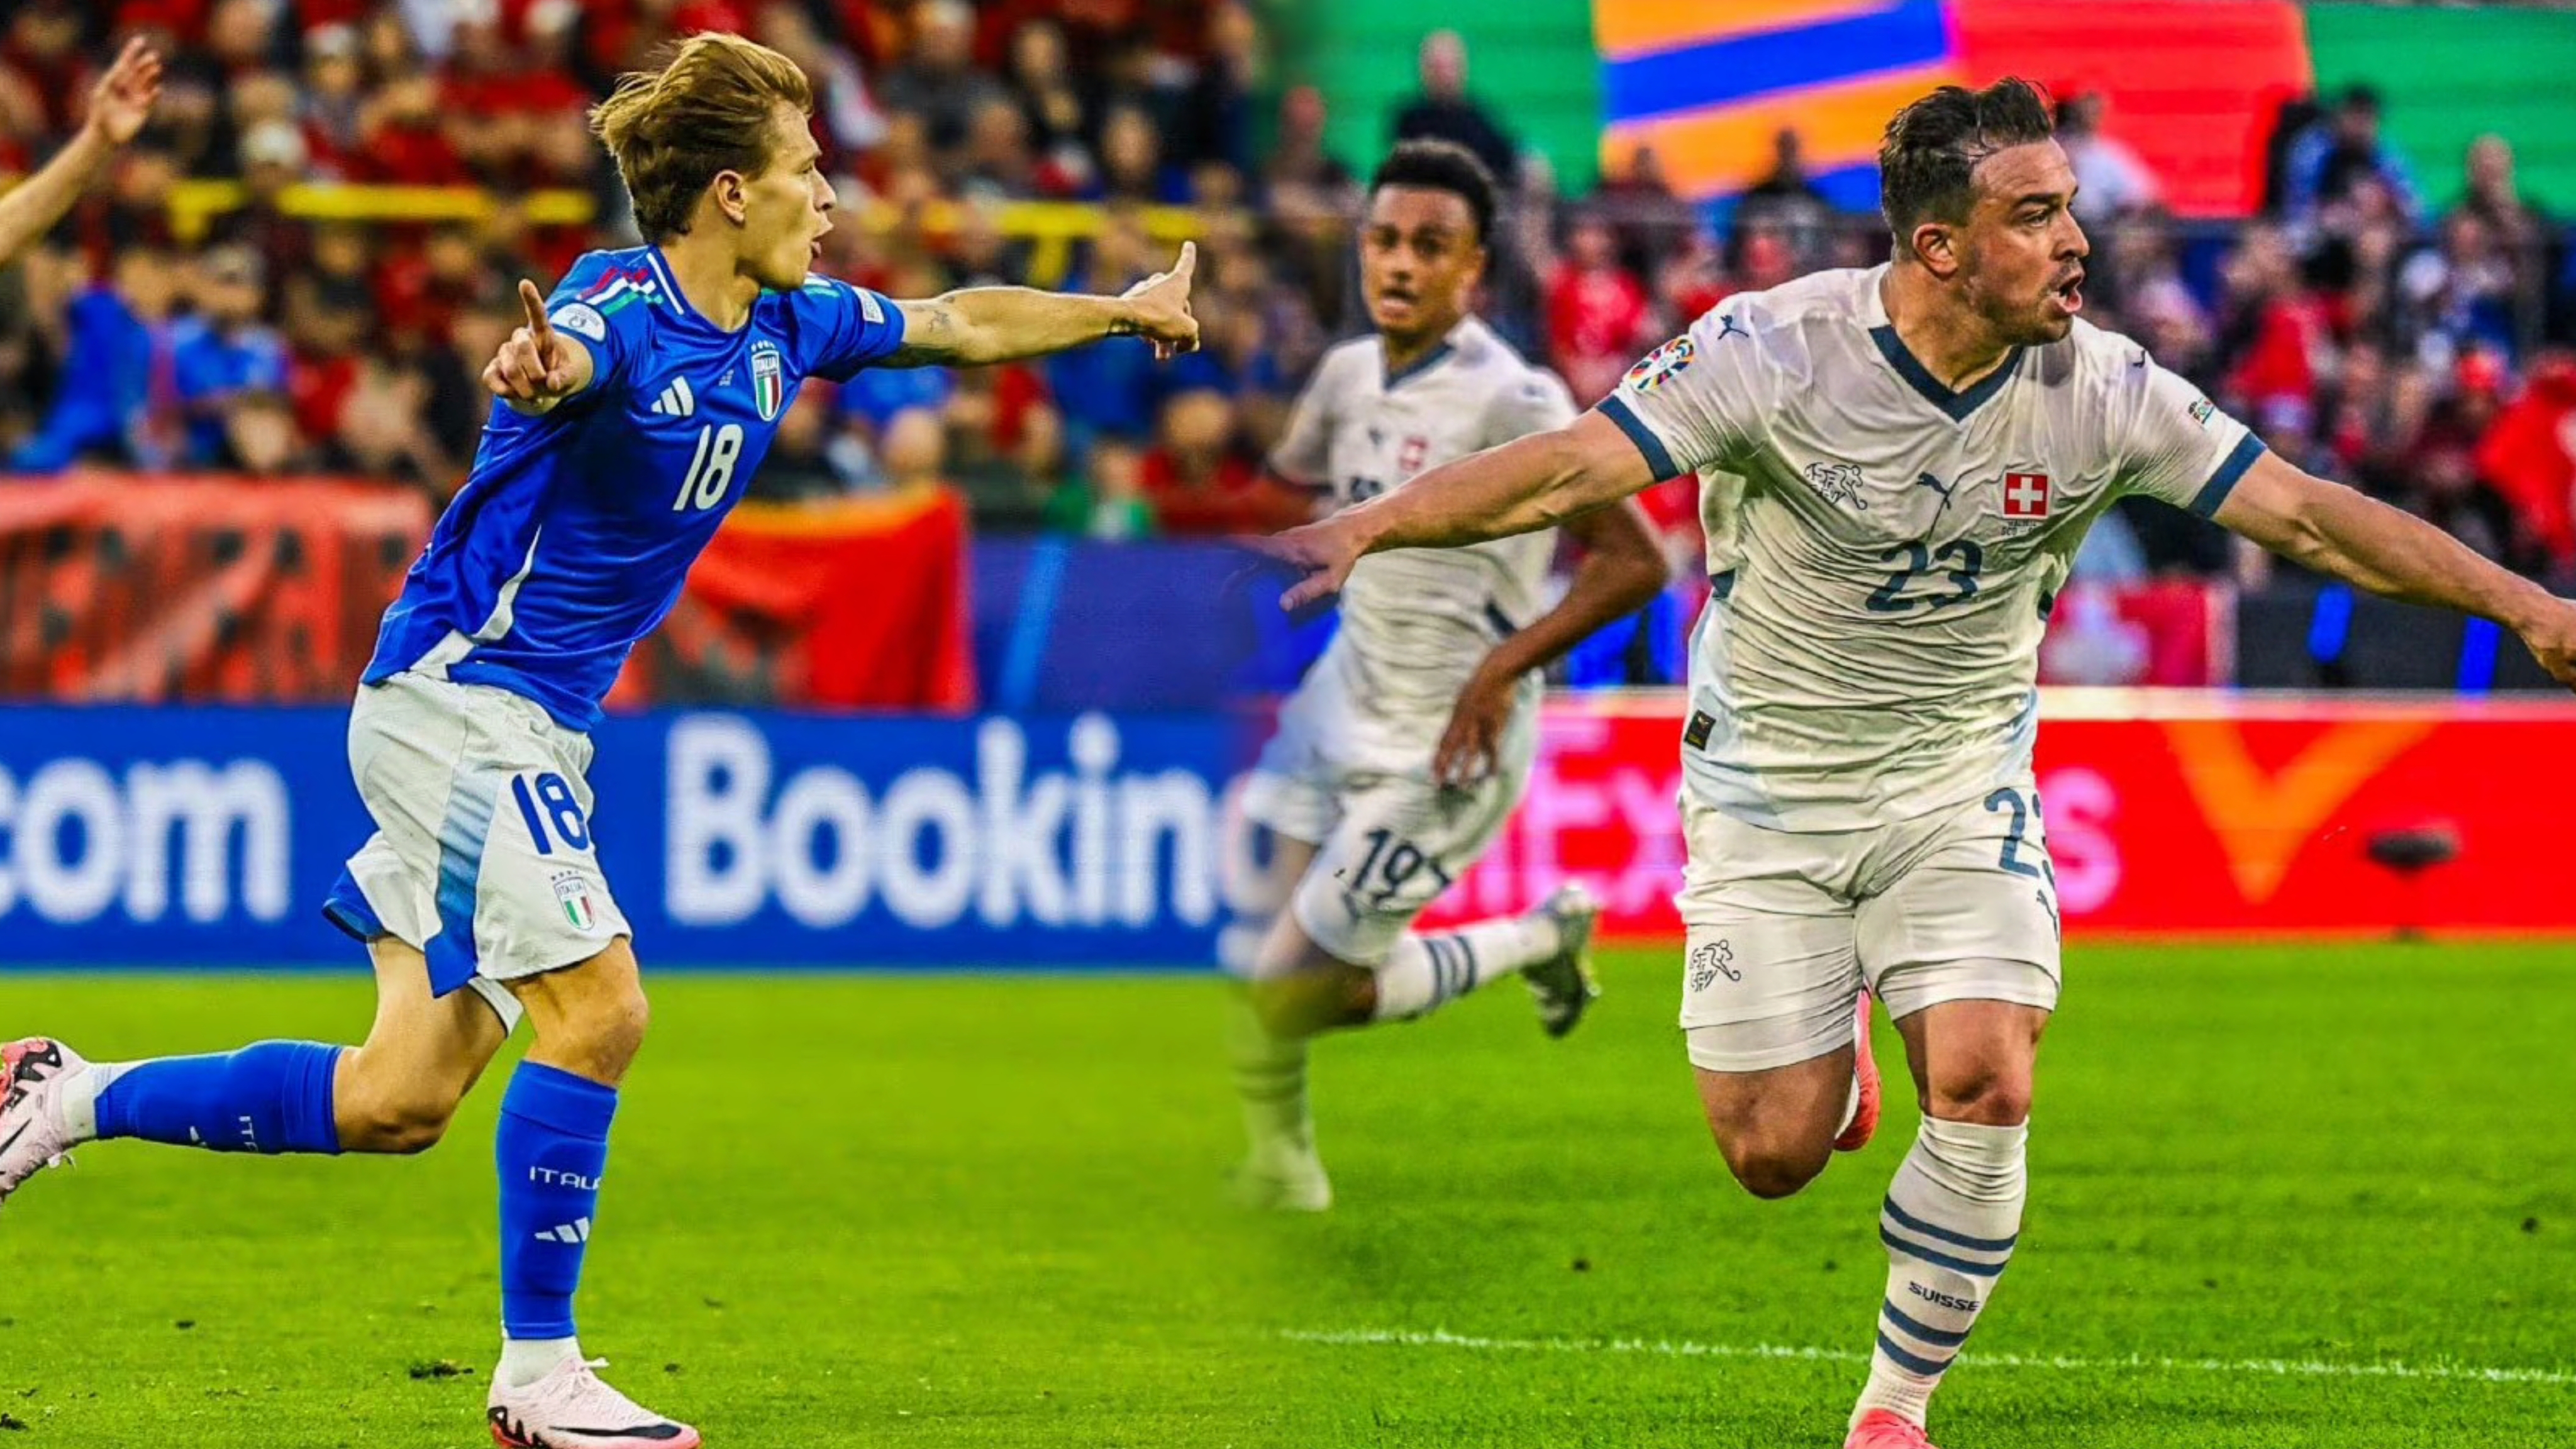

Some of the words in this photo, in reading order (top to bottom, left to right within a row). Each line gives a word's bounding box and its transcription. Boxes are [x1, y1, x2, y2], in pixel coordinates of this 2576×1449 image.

[672, 424, 743, 511] 18
[1866, 540, 1982, 611] 23
[0, 757, 292, 924] om
[511, 772, 589, 855] 18
[1908, 1280, 1980, 1312] SUISSE
